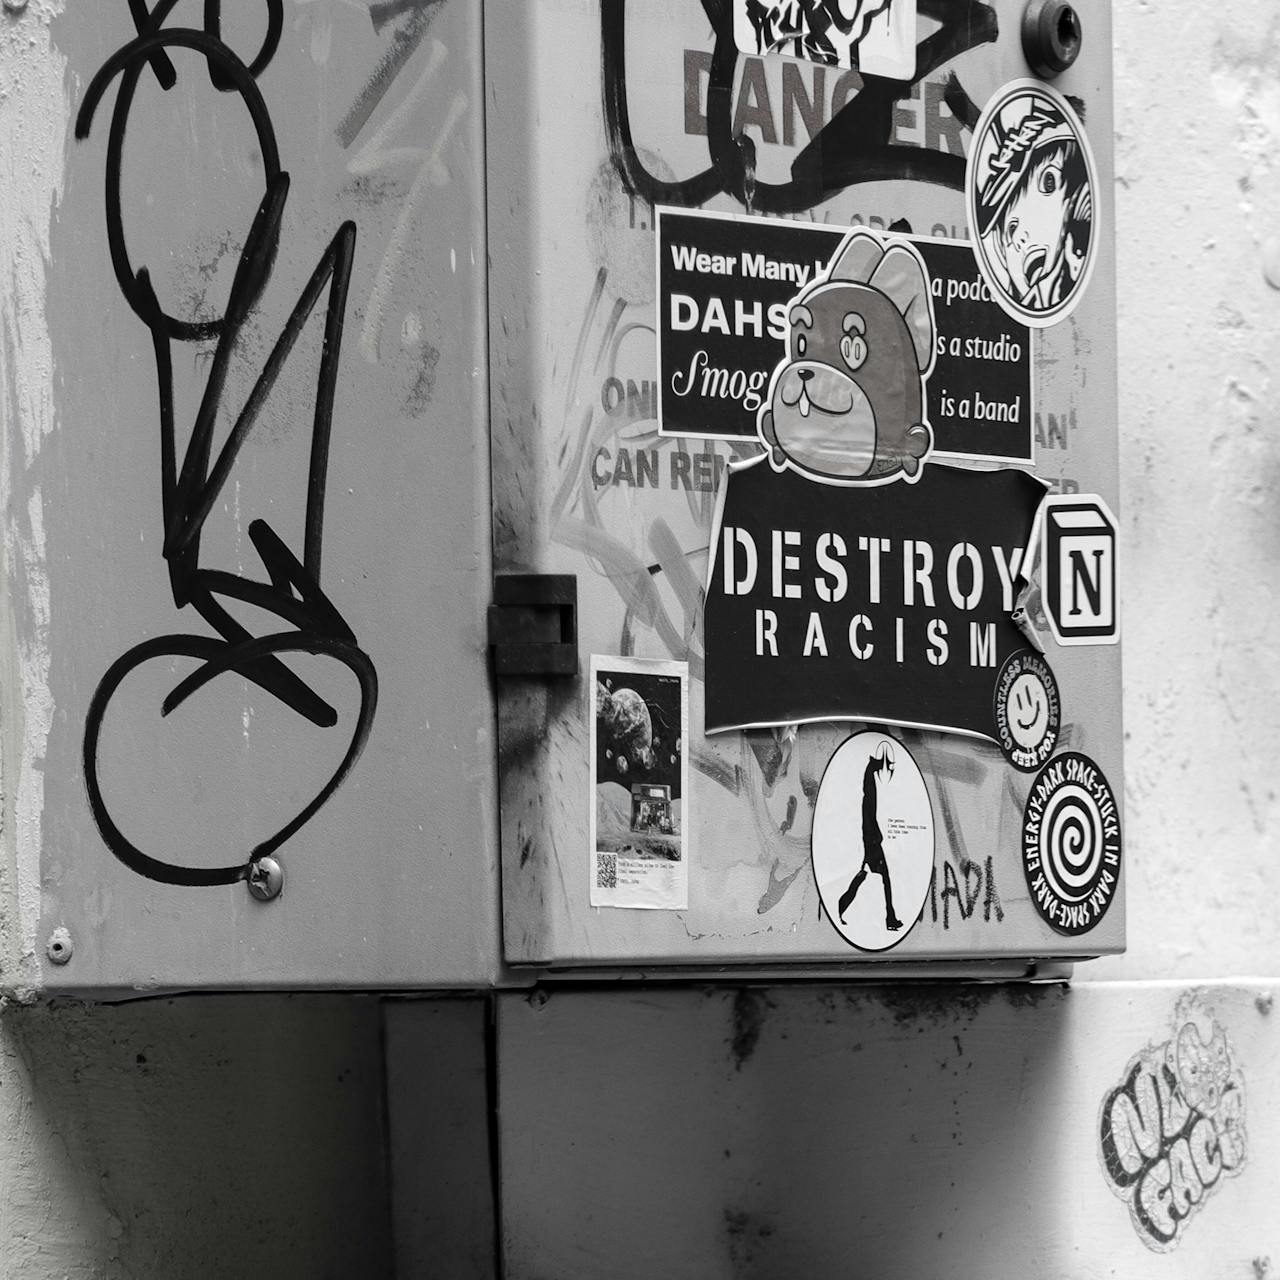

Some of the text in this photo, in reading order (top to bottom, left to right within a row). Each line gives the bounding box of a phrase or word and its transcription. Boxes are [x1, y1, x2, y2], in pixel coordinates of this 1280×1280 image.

[670, 245, 736, 276] Wear
[741, 253, 811, 288] Many
[931, 281, 944, 297] a
[949, 340, 961, 356] a
[964, 336, 1021, 363] studio
[940, 391, 1020, 424] is a band
[591, 447, 659, 490] CAN
[722, 526, 1025, 613] DESTROY
[1068, 547, 1106, 617] N
[754, 608, 998, 669] RACISM
